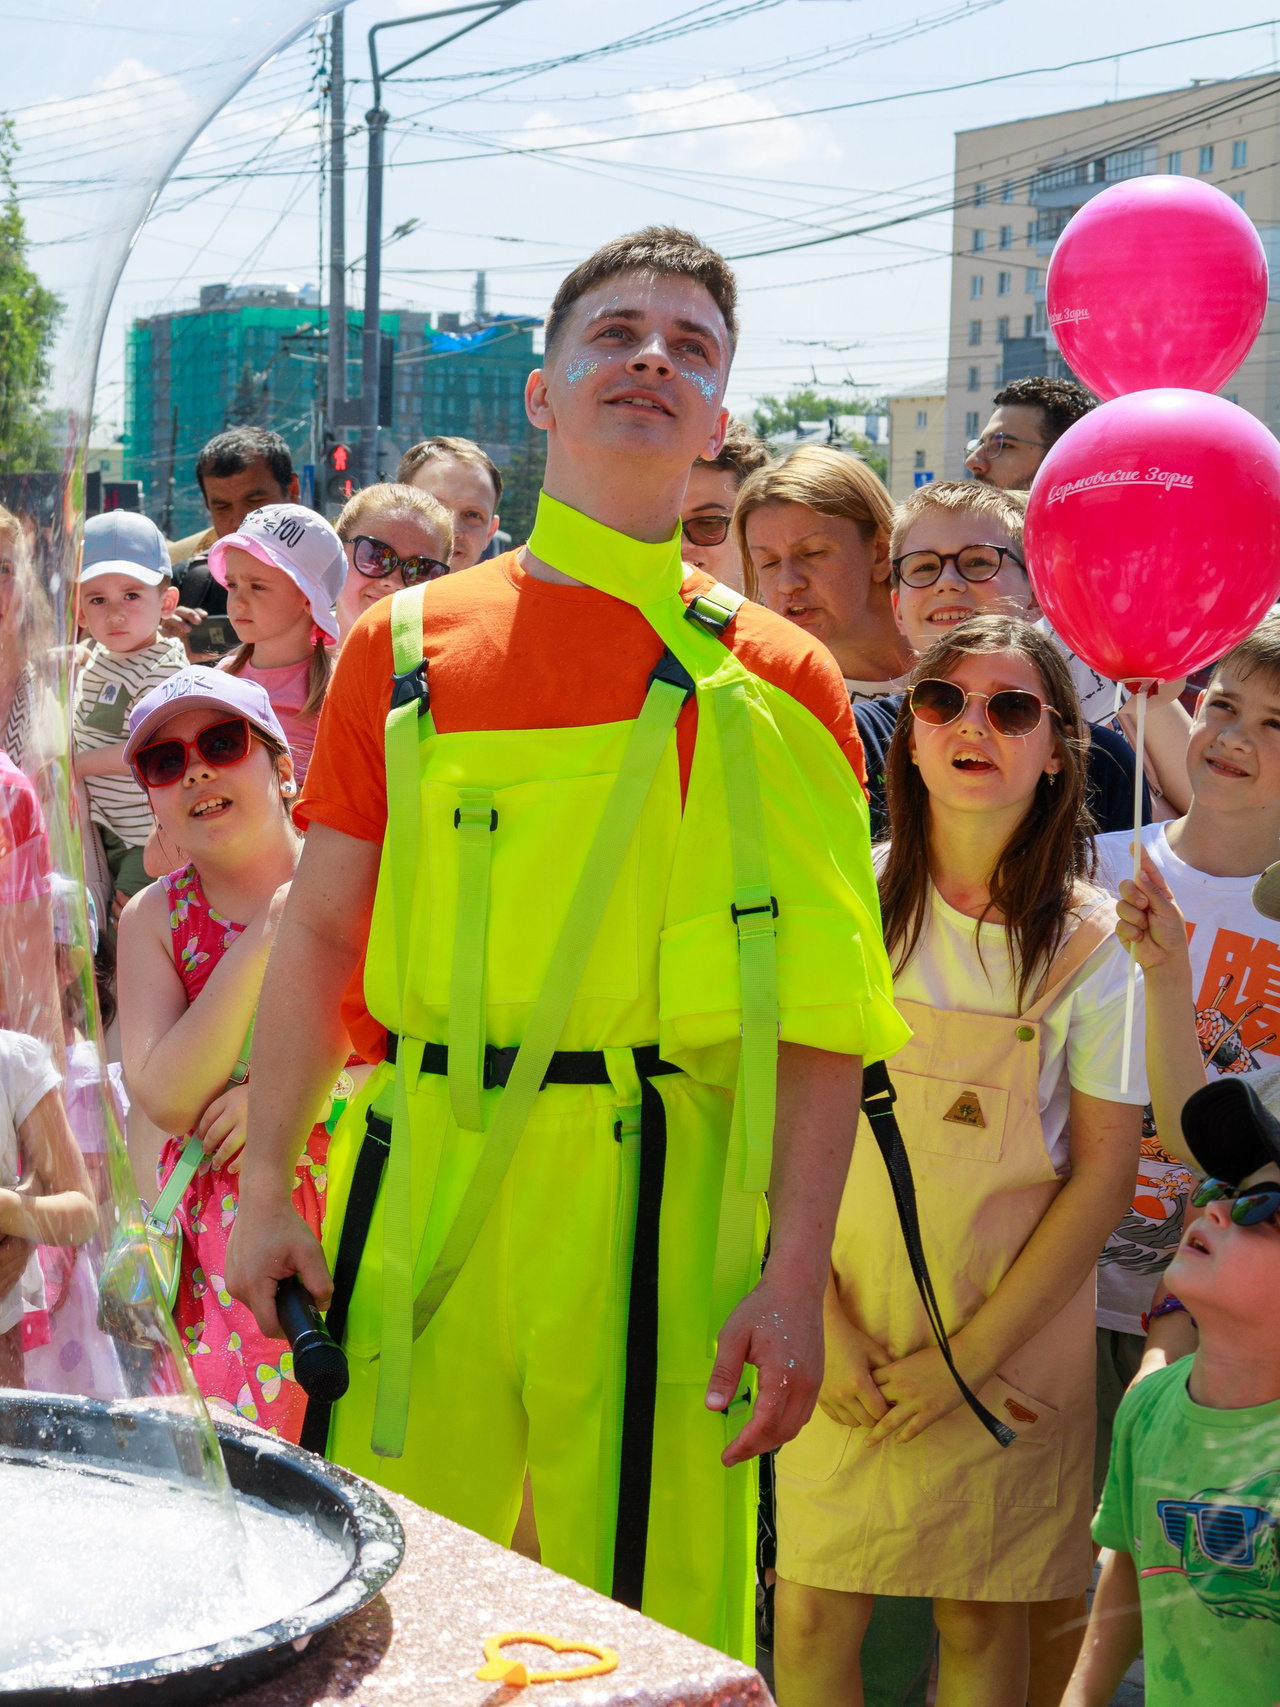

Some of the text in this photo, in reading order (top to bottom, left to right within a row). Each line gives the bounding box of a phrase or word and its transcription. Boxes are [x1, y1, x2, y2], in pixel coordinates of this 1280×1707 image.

[1064, 307, 1089, 325] Зори
[1048, 466, 1194, 504] Сормовские Зори
[273, 516, 306, 549] YOU
